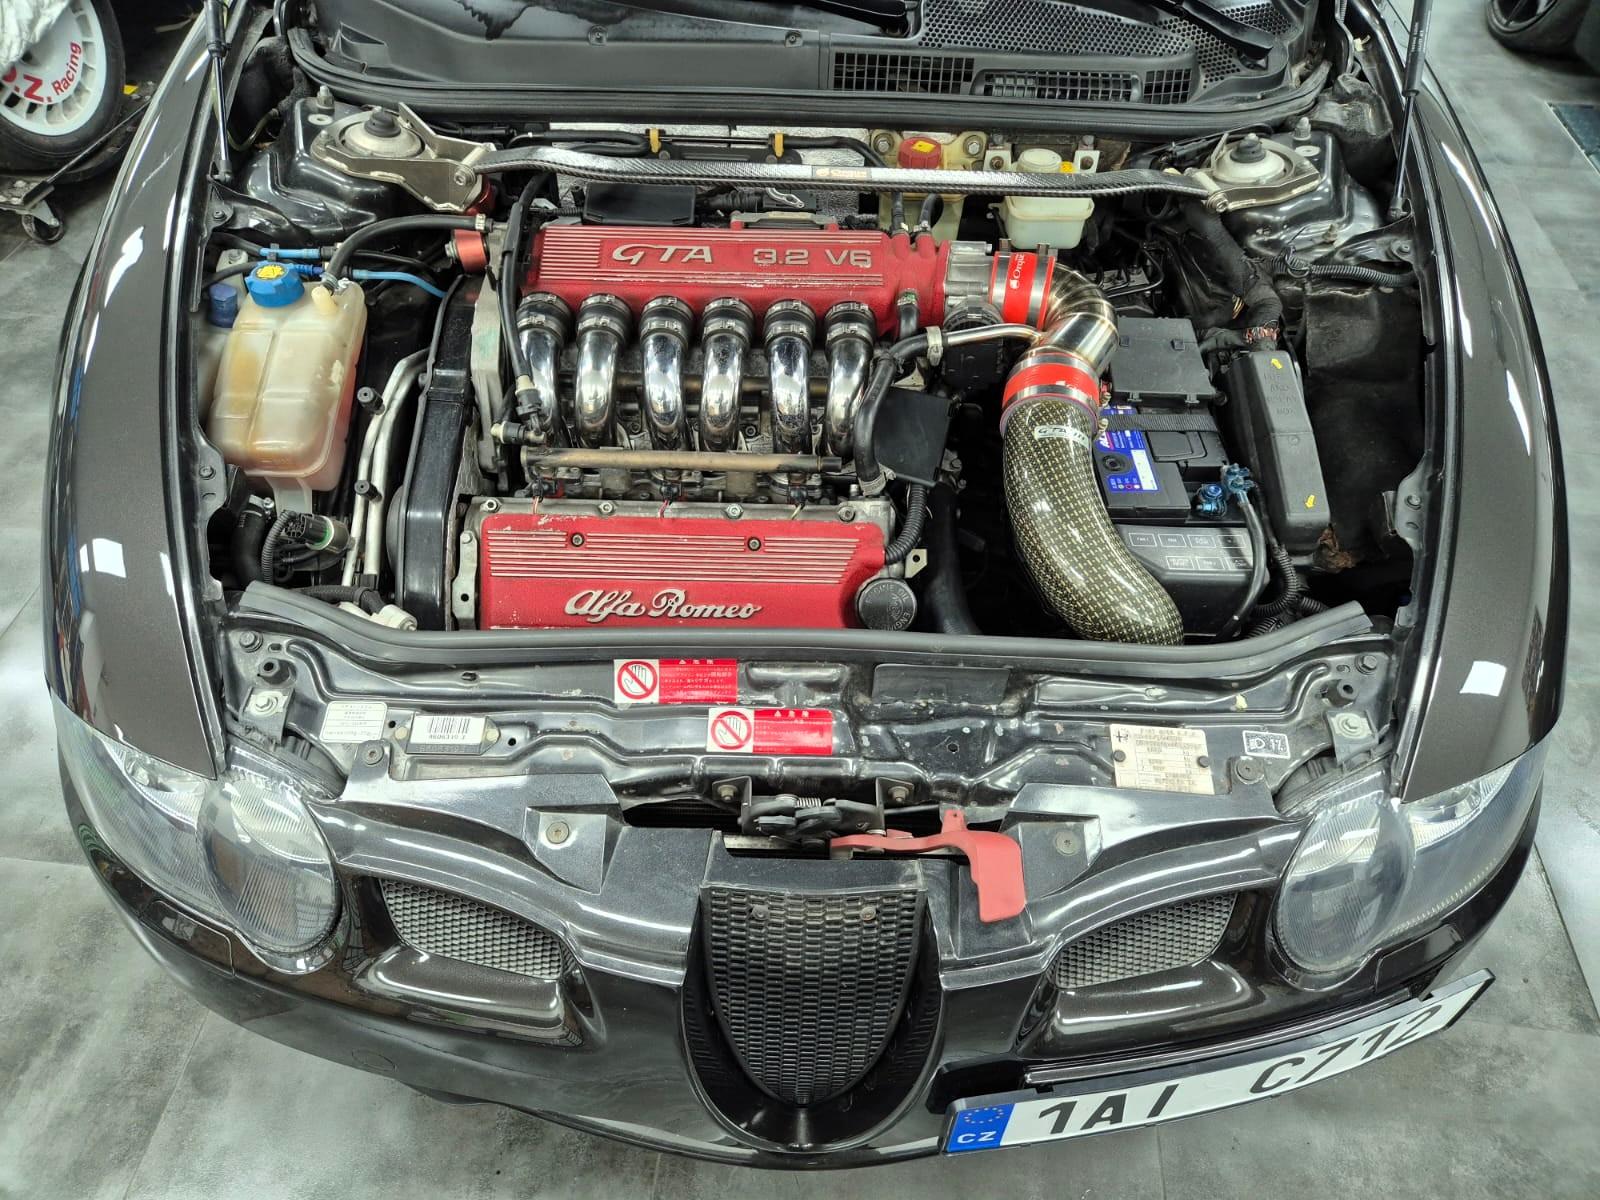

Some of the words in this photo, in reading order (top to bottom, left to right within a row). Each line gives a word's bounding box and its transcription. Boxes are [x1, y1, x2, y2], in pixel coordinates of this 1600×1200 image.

[52, 42, 82, 96] Racing
[611, 243, 713, 266] GTA
[753, 248, 809, 267] 3.2
[824, 248, 872, 268] V6
[564, 589, 646, 623] Alfa
[648, 588, 762, 619] Romeo
[957, 1130, 995, 1144] CZ
